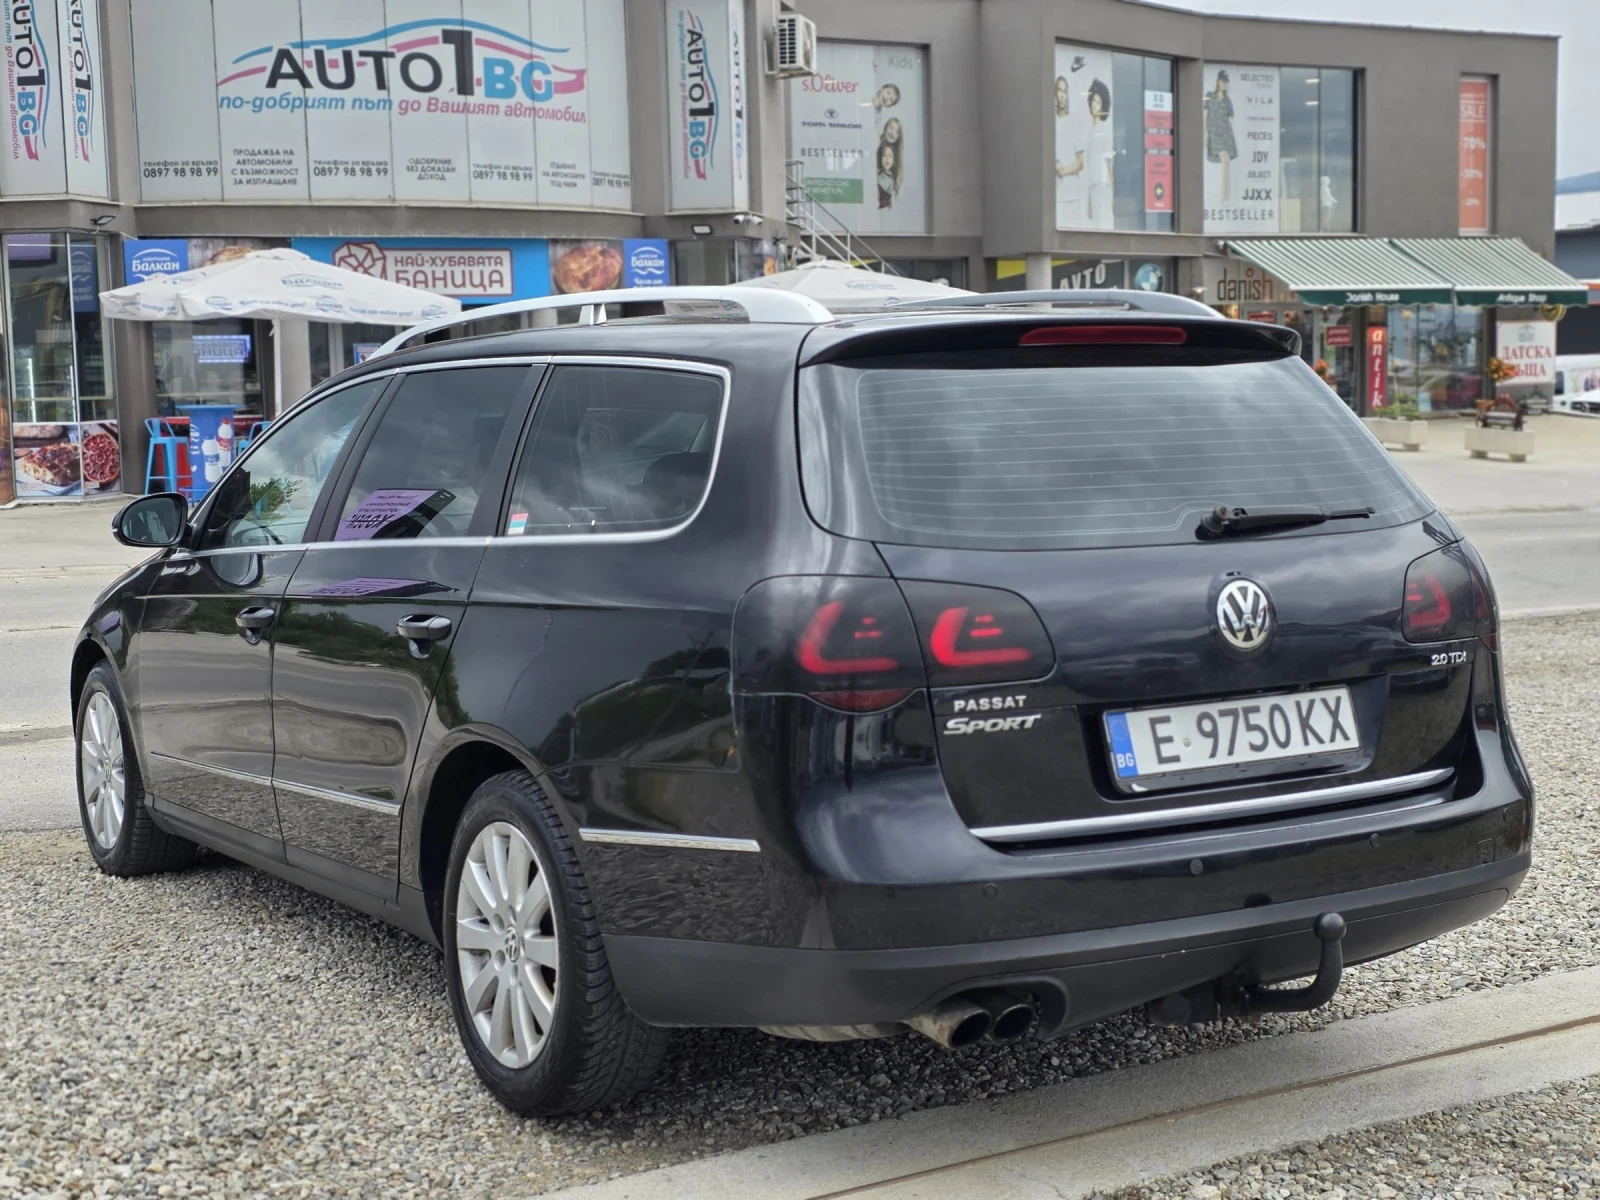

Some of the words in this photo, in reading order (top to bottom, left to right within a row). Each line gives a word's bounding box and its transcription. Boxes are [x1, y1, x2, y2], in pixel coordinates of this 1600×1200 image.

[889, 56, 913, 70] Kids
[802, 73, 860, 94] s.Oliver
[1240, 73, 1274, 83] SELECTED
[219, 91, 345, 114] по-добрият
[351, 96, 393, 111] път
[397, 99, 421, 116] до
[426, 96, 500, 116] Вашият
[504, 101, 587, 123] автомобил
[1459, 104, 1485, 119] SALE
[1246, 131, 1273, 141] PIECES
[233, 149, 280, 157] ПРОДАЖБА
[283, 149, 295, 157] НА
[801, 148, 865, 159] BESTSELLER
[1252, 150, 1269, 163] JDY
[143, 160, 179, 168] телефон
[191, 160, 218, 168] връзка
[236, 158, 293, 166] АВТОМОБИЛИ
[313, 159, 349, 167] телефон
[408, 158, 452, 166] ОДОБРЕНИЕ
[143, 167, 170, 178] 0897
[173, 167, 186, 178] 98
[190, 167, 203, 177] 98
[205, 166, 219, 177] 99
[231, 168, 238, 176] С
[239, 168, 298, 176] ВЪЗМОЖНОСТ
[313, 166, 340, 177] 0897
[343, 166, 356, 177] 98
[360, 166, 373, 177] 98
[375, 167, 389, 177] 99
[406, 165, 418, 173] БЕЗ
[420, 165, 456, 174] ДОКАЗАН
[233, 178, 244, 186] ЗА
[246, 178, 297, 186] ИЗПЛАЩАНЕ
[417, 173, 446, 181] ДОХОД
[472, 170, 494, 180] 0897
[496, 171, 507, 181] 98
[510, 171, 520, 182] 98
[522, 172, 533, 182] 99
[1241, 188, 1273, 201] JJXX
[1203, 209, 1274, 221] BESTSELLER
[131, 259, 180, 272] Балкан
[393, 253, 504, 267] НАЙ-ХУБАВАТА
[631, 256, 665, 268] Балкан
[395, 269, 504, 292] БАНИЦА
[1217, 268, 1273, 301] danish
[1375, 291, 1400, 302] House
[1502, 345, 1552, 360] ДАТСКА
[1371, 328, 1383, 408] antik
[1514, 363, 1546, 379] ЪЩА
[1448, 650, 1467, 664] TDI
[953, 695, 1026, 712] PASSAT
[1116, 752, 1135, 769] BG
[1148, 715, 1181, 765] E
